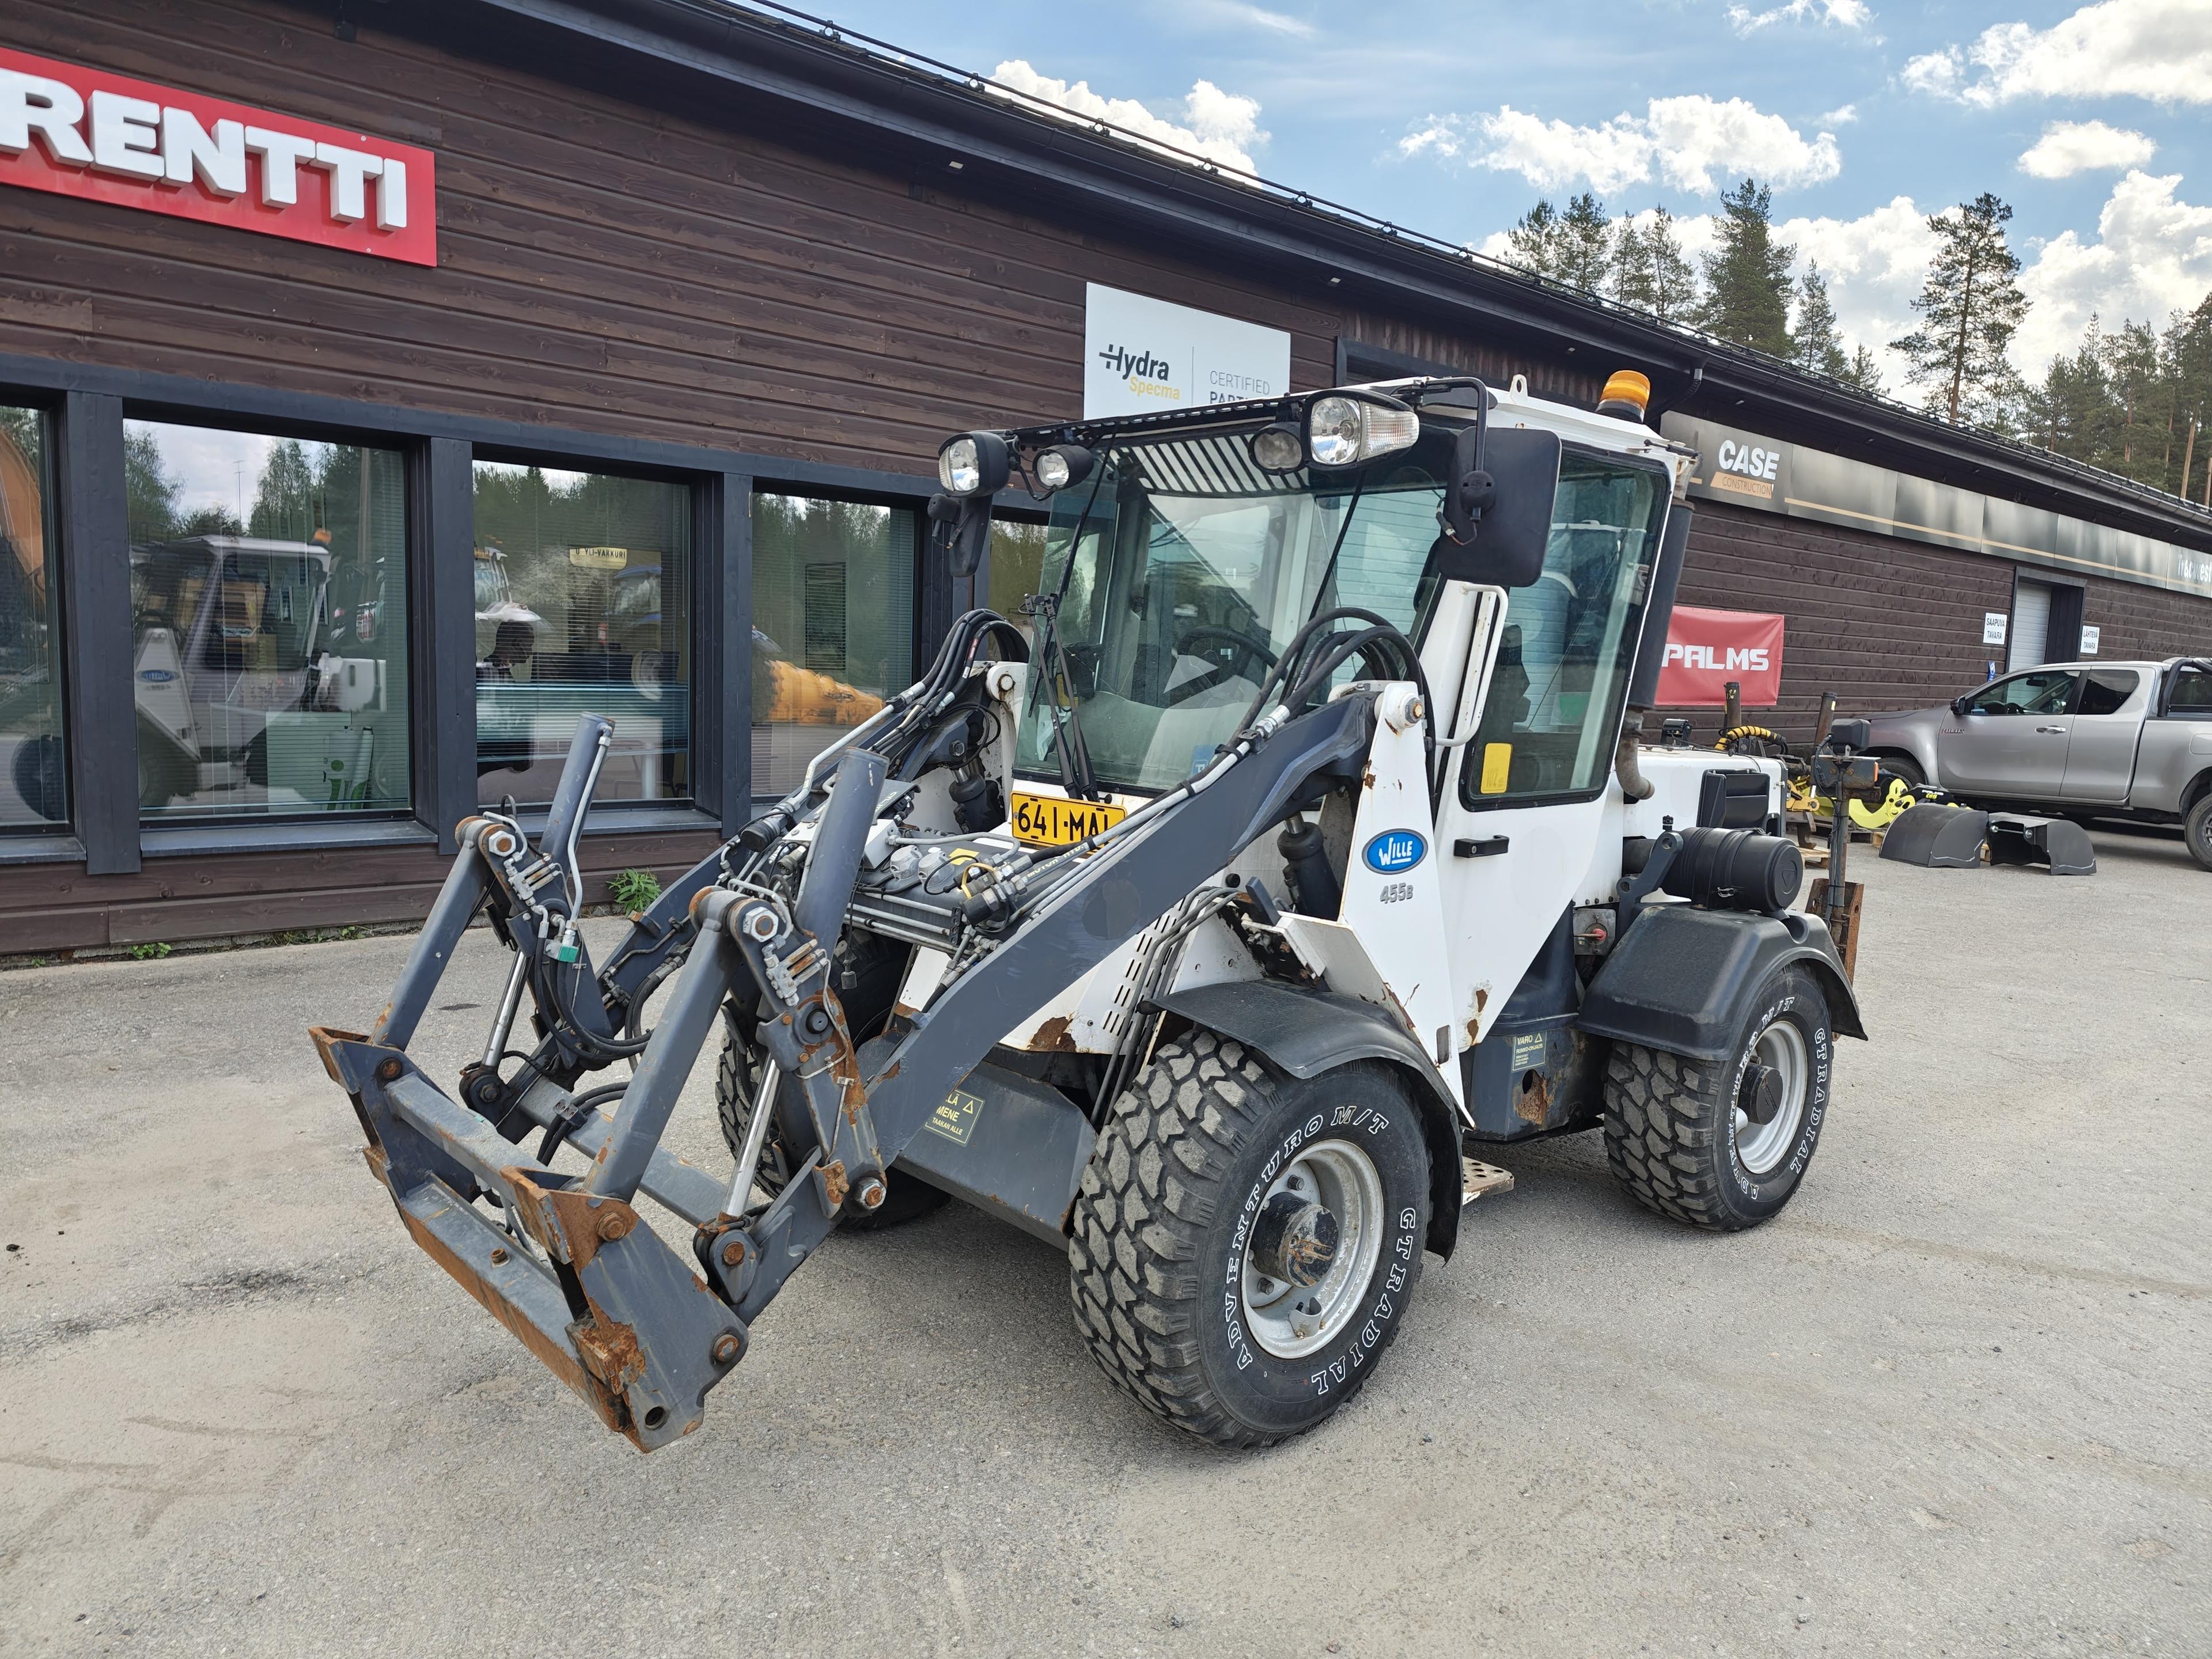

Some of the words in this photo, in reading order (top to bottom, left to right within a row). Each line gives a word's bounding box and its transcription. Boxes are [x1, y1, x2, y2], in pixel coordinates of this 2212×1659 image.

[0, 67, 407, 230] RENTTI
[1099, 343, 1169, 381] Hydra
[1129, 376, 1180, 400] Specma
[1210, 370, 1270, 395] CERTIFIED
[1718, 440, 1780, 480] CASE
[1722, 476, 1772, 496] CONSTRUCTION
[585, 547, 626, 559] YLI-VAKKURI
[1986, 618, 2005, 627] SAAPUVA
[1987, 631, 2002, 639] TAVARA
[1661, 643, 1769, 671] PALMS
[1380, 882, 1414, 904] 455B
[1517, 1035, 1533, 1045] VARO
[945, 1093, 960, 1106] LÄ
[935, 1105, 960, 1122] MENE
[932, 1117, 950, 1130] TAAKAN
[950, 1125, 963, 1135] ALLE
[1225, 1114, 1324, 1370] ADVENTURO
[1330, 1105, 1389, 1134] M/T
